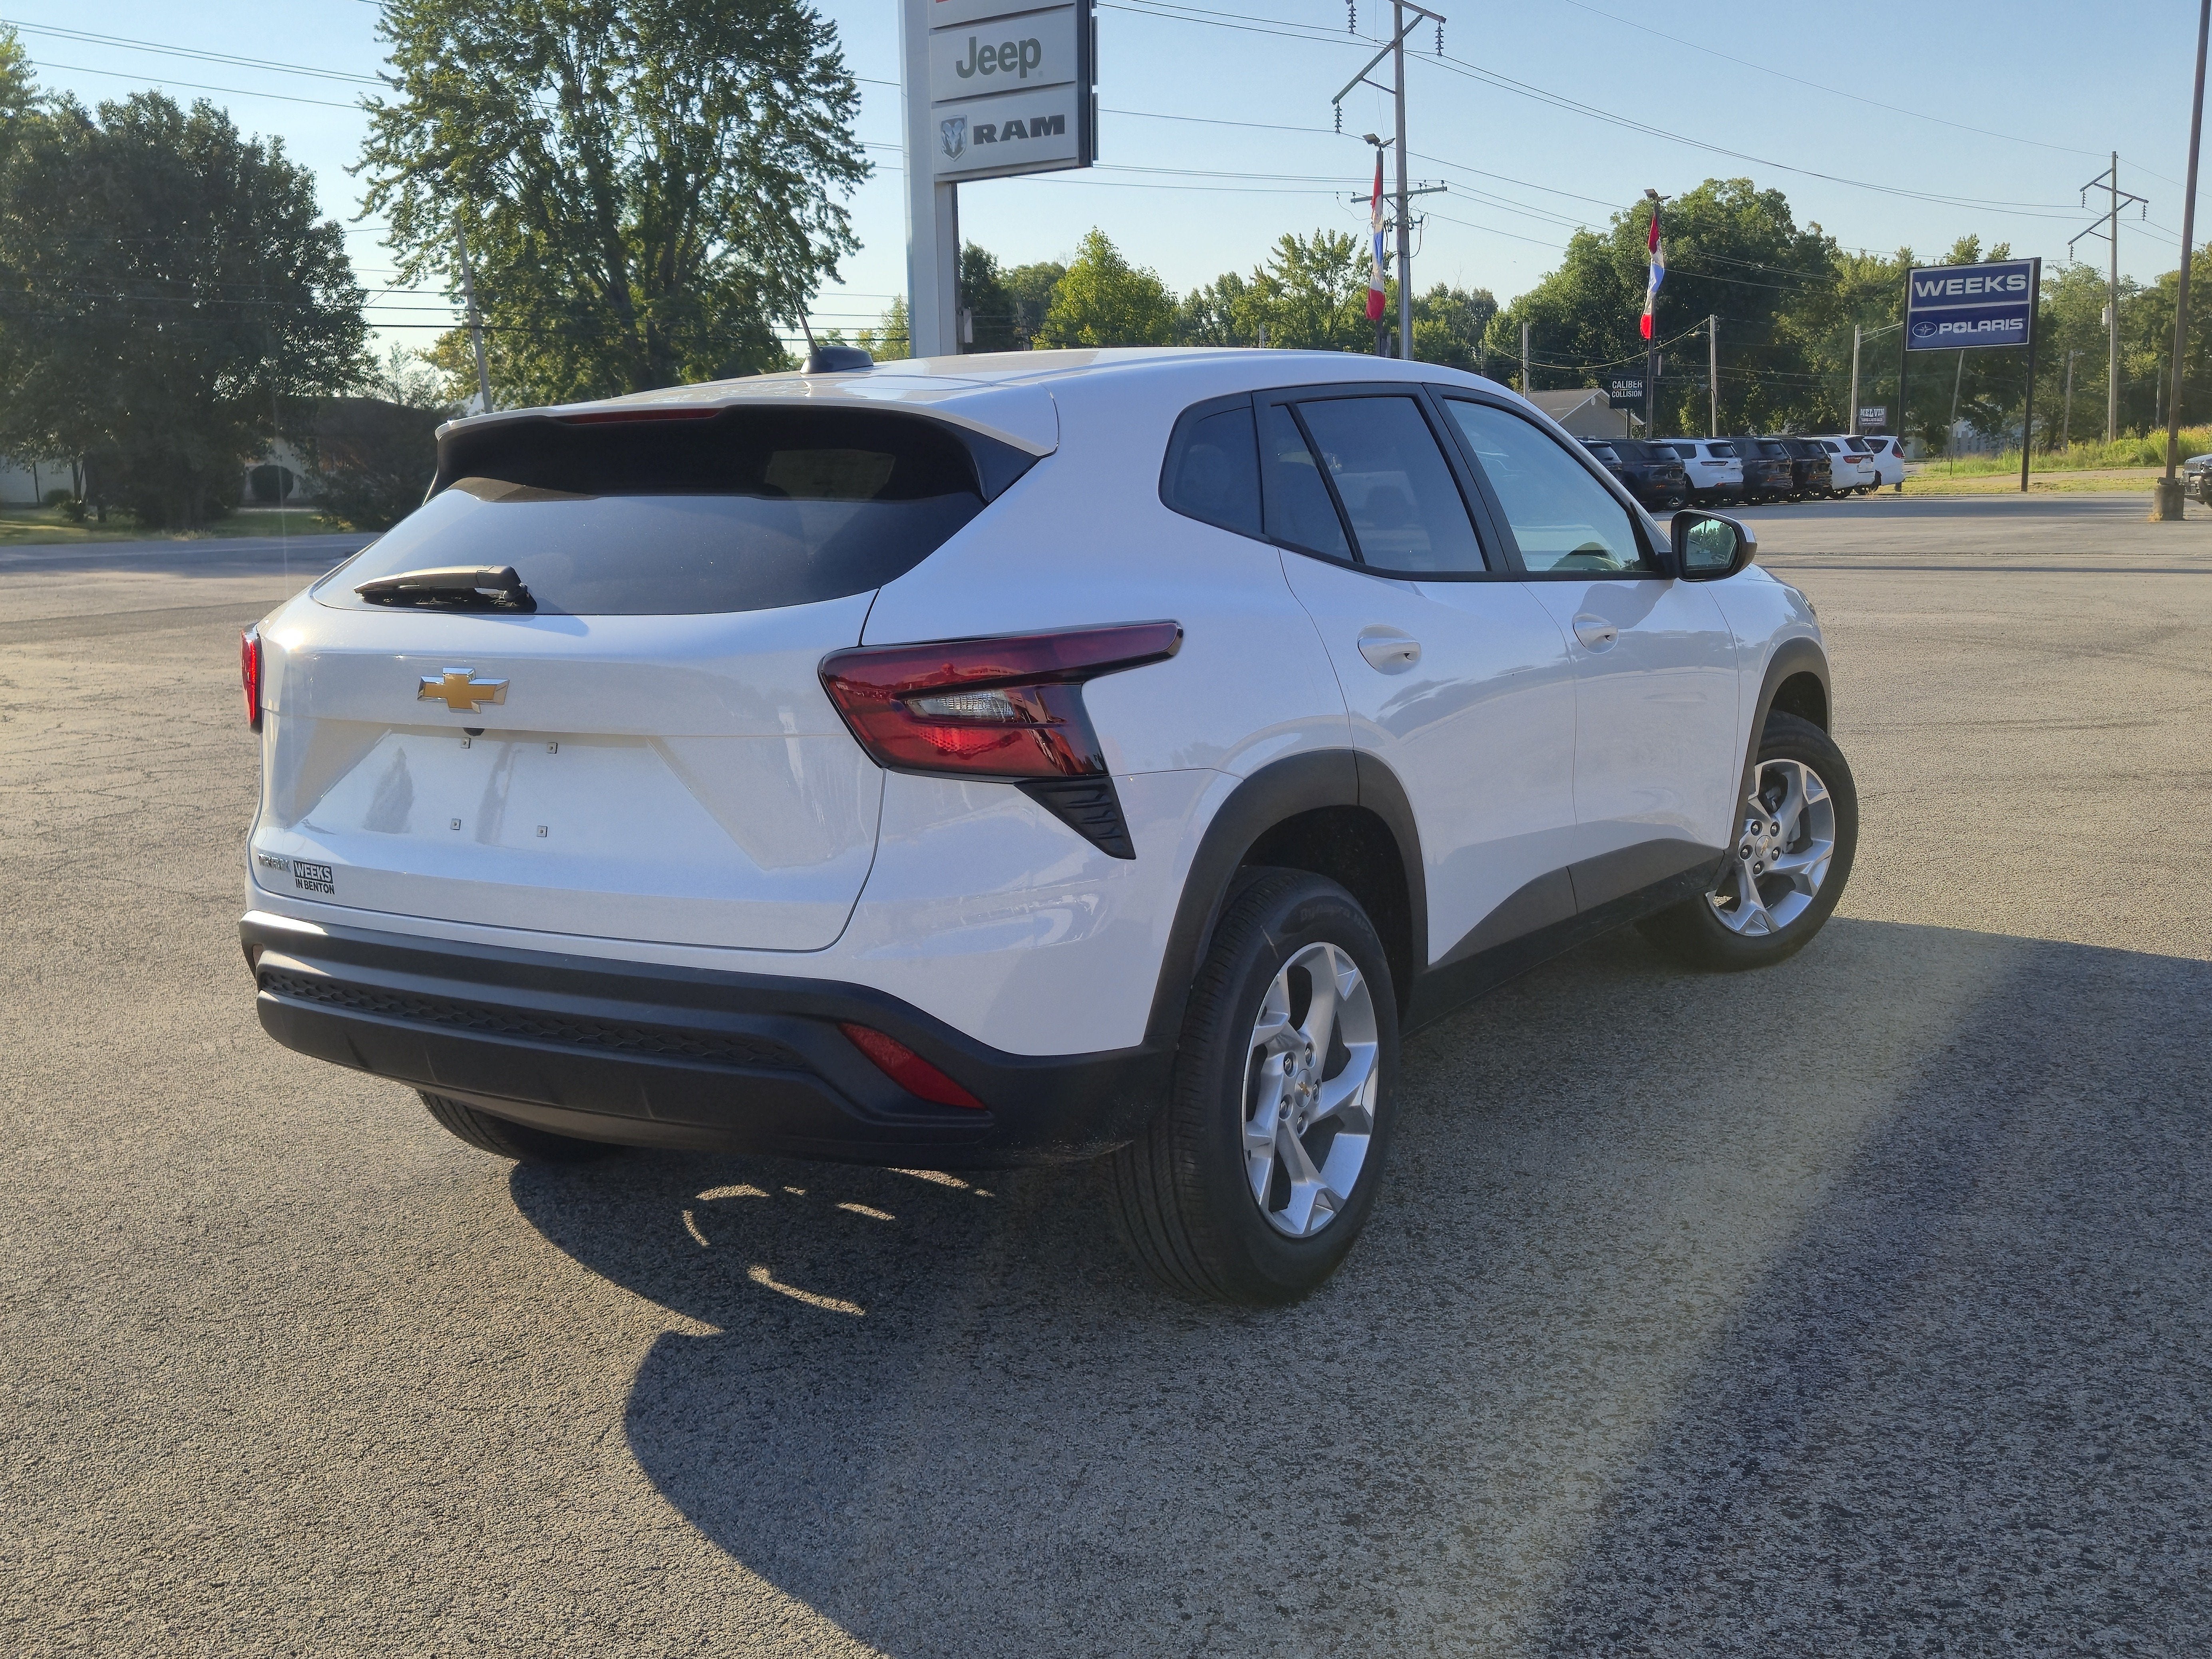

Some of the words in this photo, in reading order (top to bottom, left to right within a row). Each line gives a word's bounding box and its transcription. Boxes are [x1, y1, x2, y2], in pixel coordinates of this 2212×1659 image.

[956, 36, 1041, 78] Jeep
[973, 114, 1065, 145] RAM
[1915, 274, 2026, 297] WEEKS
[1939, 318, 2023, 334] POLARIS
[1612, 380, 1642, 389] CALIBER
[294, 861, 332, 882] WEEKS
[296, 878, 303, 889] IN
[304, 880, 335, 895] BENTON
